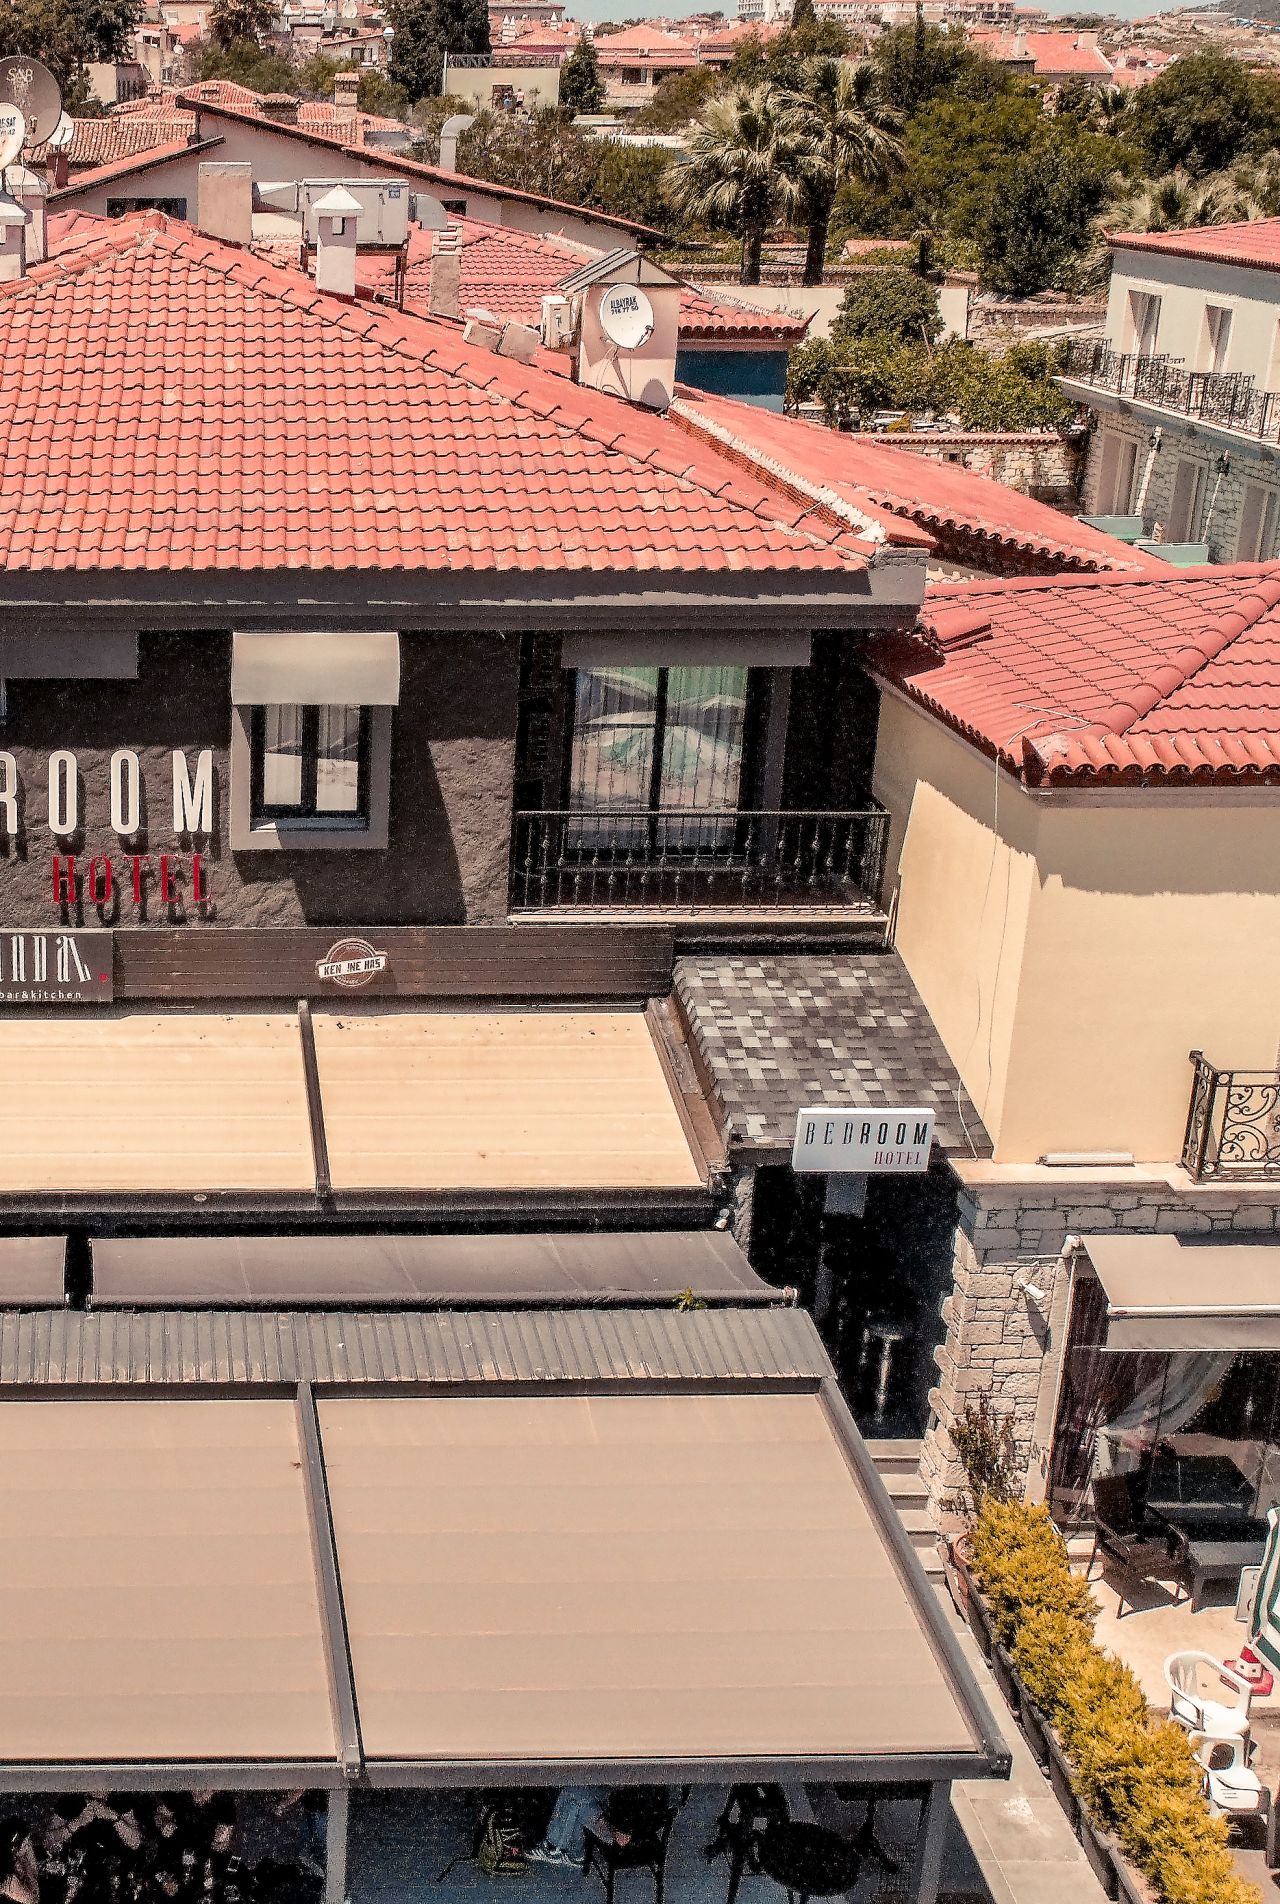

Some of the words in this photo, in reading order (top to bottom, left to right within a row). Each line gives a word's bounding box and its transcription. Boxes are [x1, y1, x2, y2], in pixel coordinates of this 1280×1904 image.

[610, 295, 638, 309] ALBAYRAK
[52, 853, 212, 905] HOTEL
[804, 1122, 928, 1145] BEDROOM
[874, 1151, 922, 1165] HOTEL
